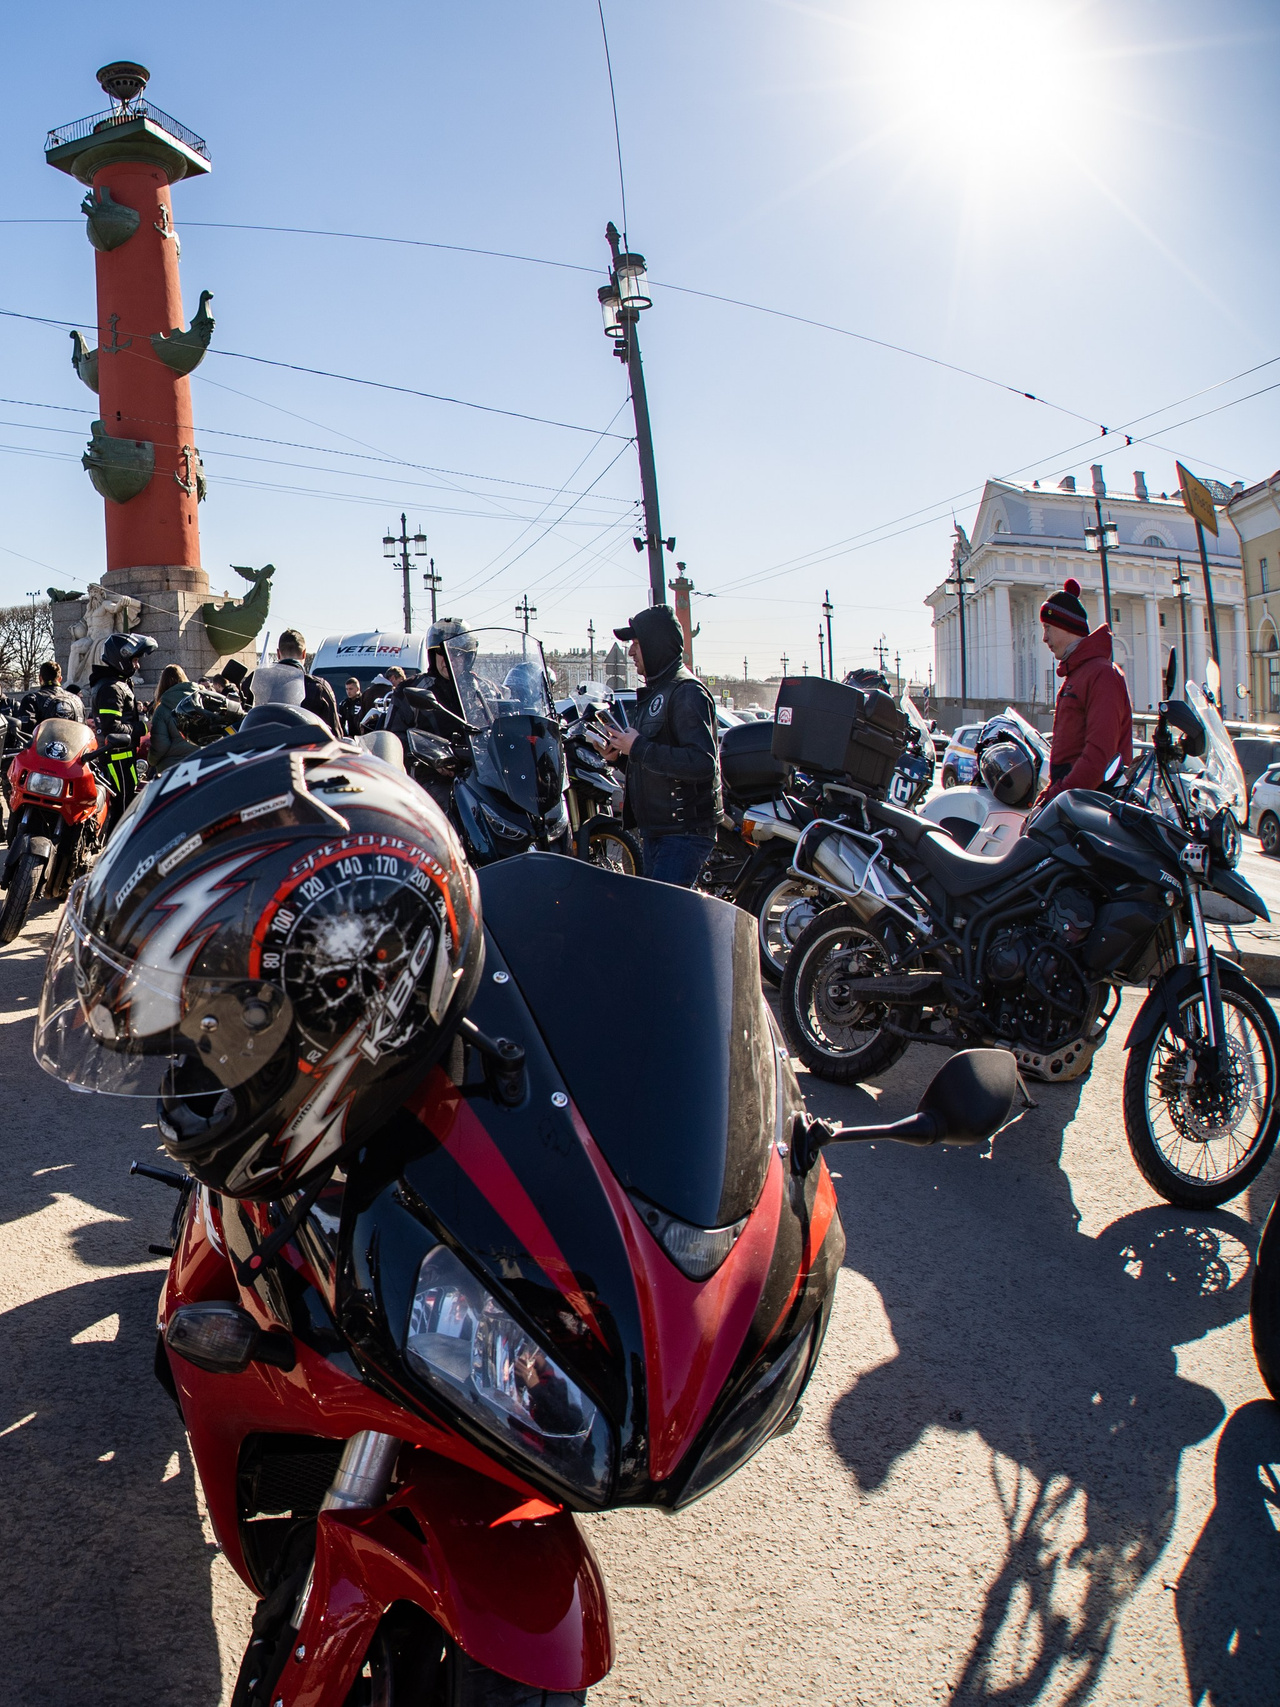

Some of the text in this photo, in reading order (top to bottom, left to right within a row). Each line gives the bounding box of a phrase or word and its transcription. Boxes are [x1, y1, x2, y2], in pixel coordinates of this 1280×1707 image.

[336, 645, 402, 655] VETERR
[336, 858, 363, 879] 140
[375, 858, 398, 876] 170
[298, 876, 325, 901] 120
[410, 868, 430, 892] 200
[271, 909, 296, 934] 100
[263, 953, 281, 969] 80
